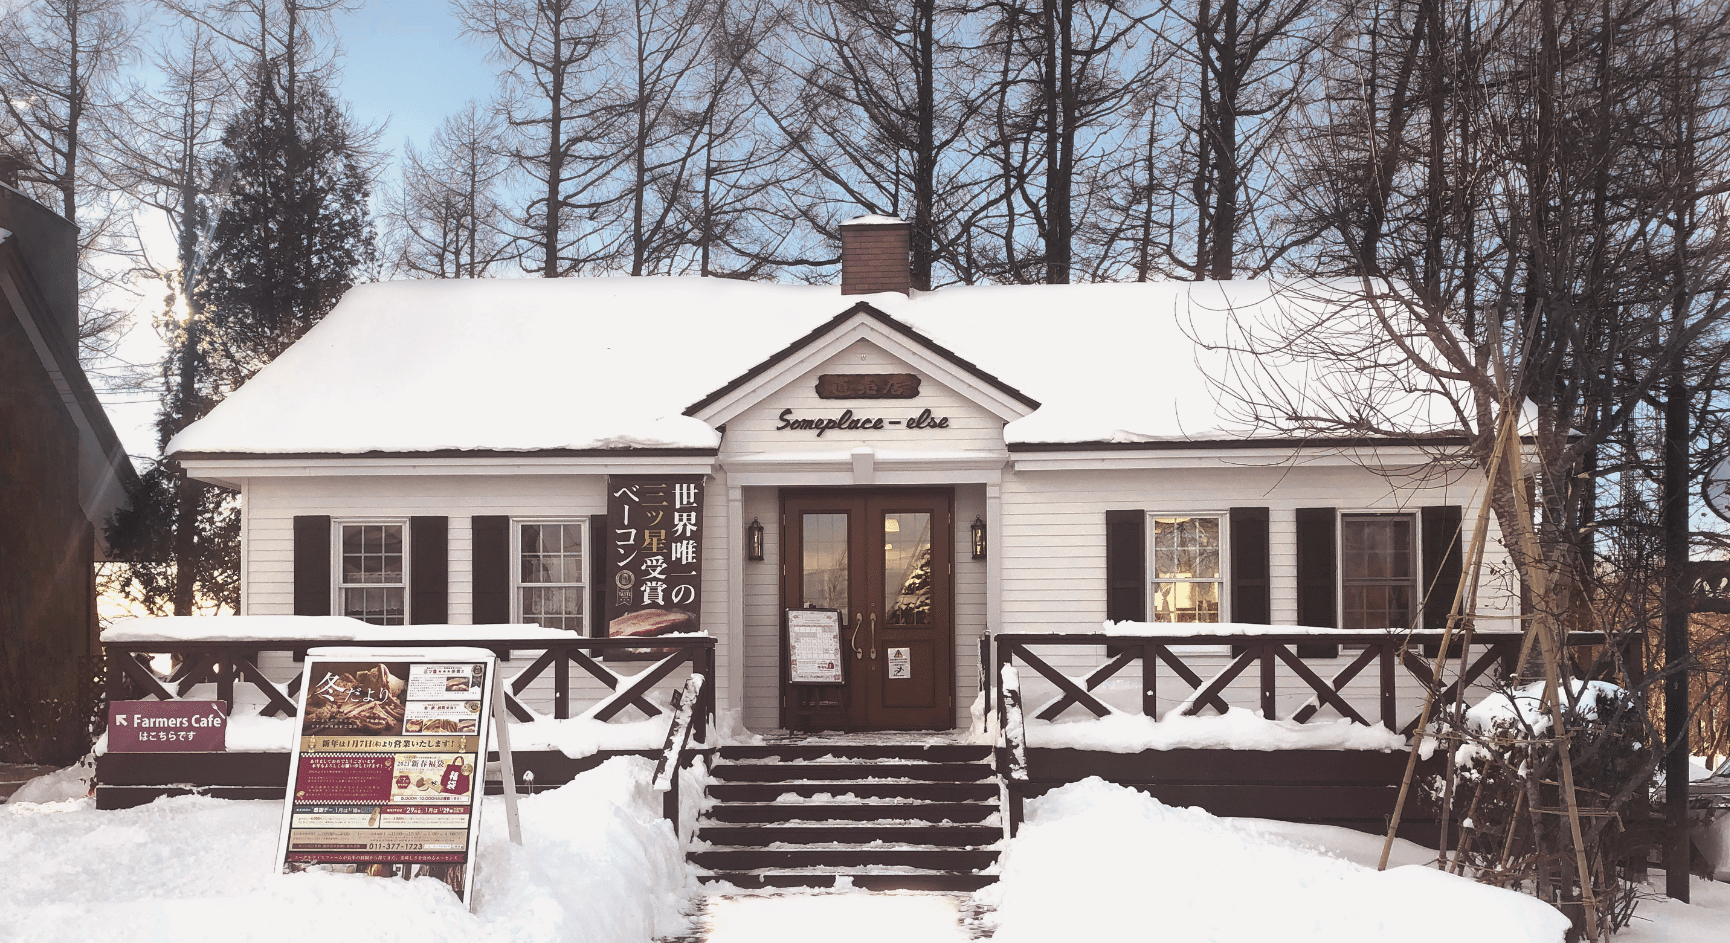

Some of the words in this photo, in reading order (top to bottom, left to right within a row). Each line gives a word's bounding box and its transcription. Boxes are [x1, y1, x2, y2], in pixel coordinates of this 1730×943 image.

[776, 407, 884, 438] Someplace
[905, 408, 950, 430] else
[613, 484, 640, 567] ベーコン
[640, 483, 669, 606] 三ツ星受賞
[670, 483, 699, 605] 世界唯一の
[314, 671, 389, 703] 冬だより
[133, 714, 189, 728] Farmers
[138, 731, 197, 741] はこちらです
[446, 770, 459, 790] 福袋
